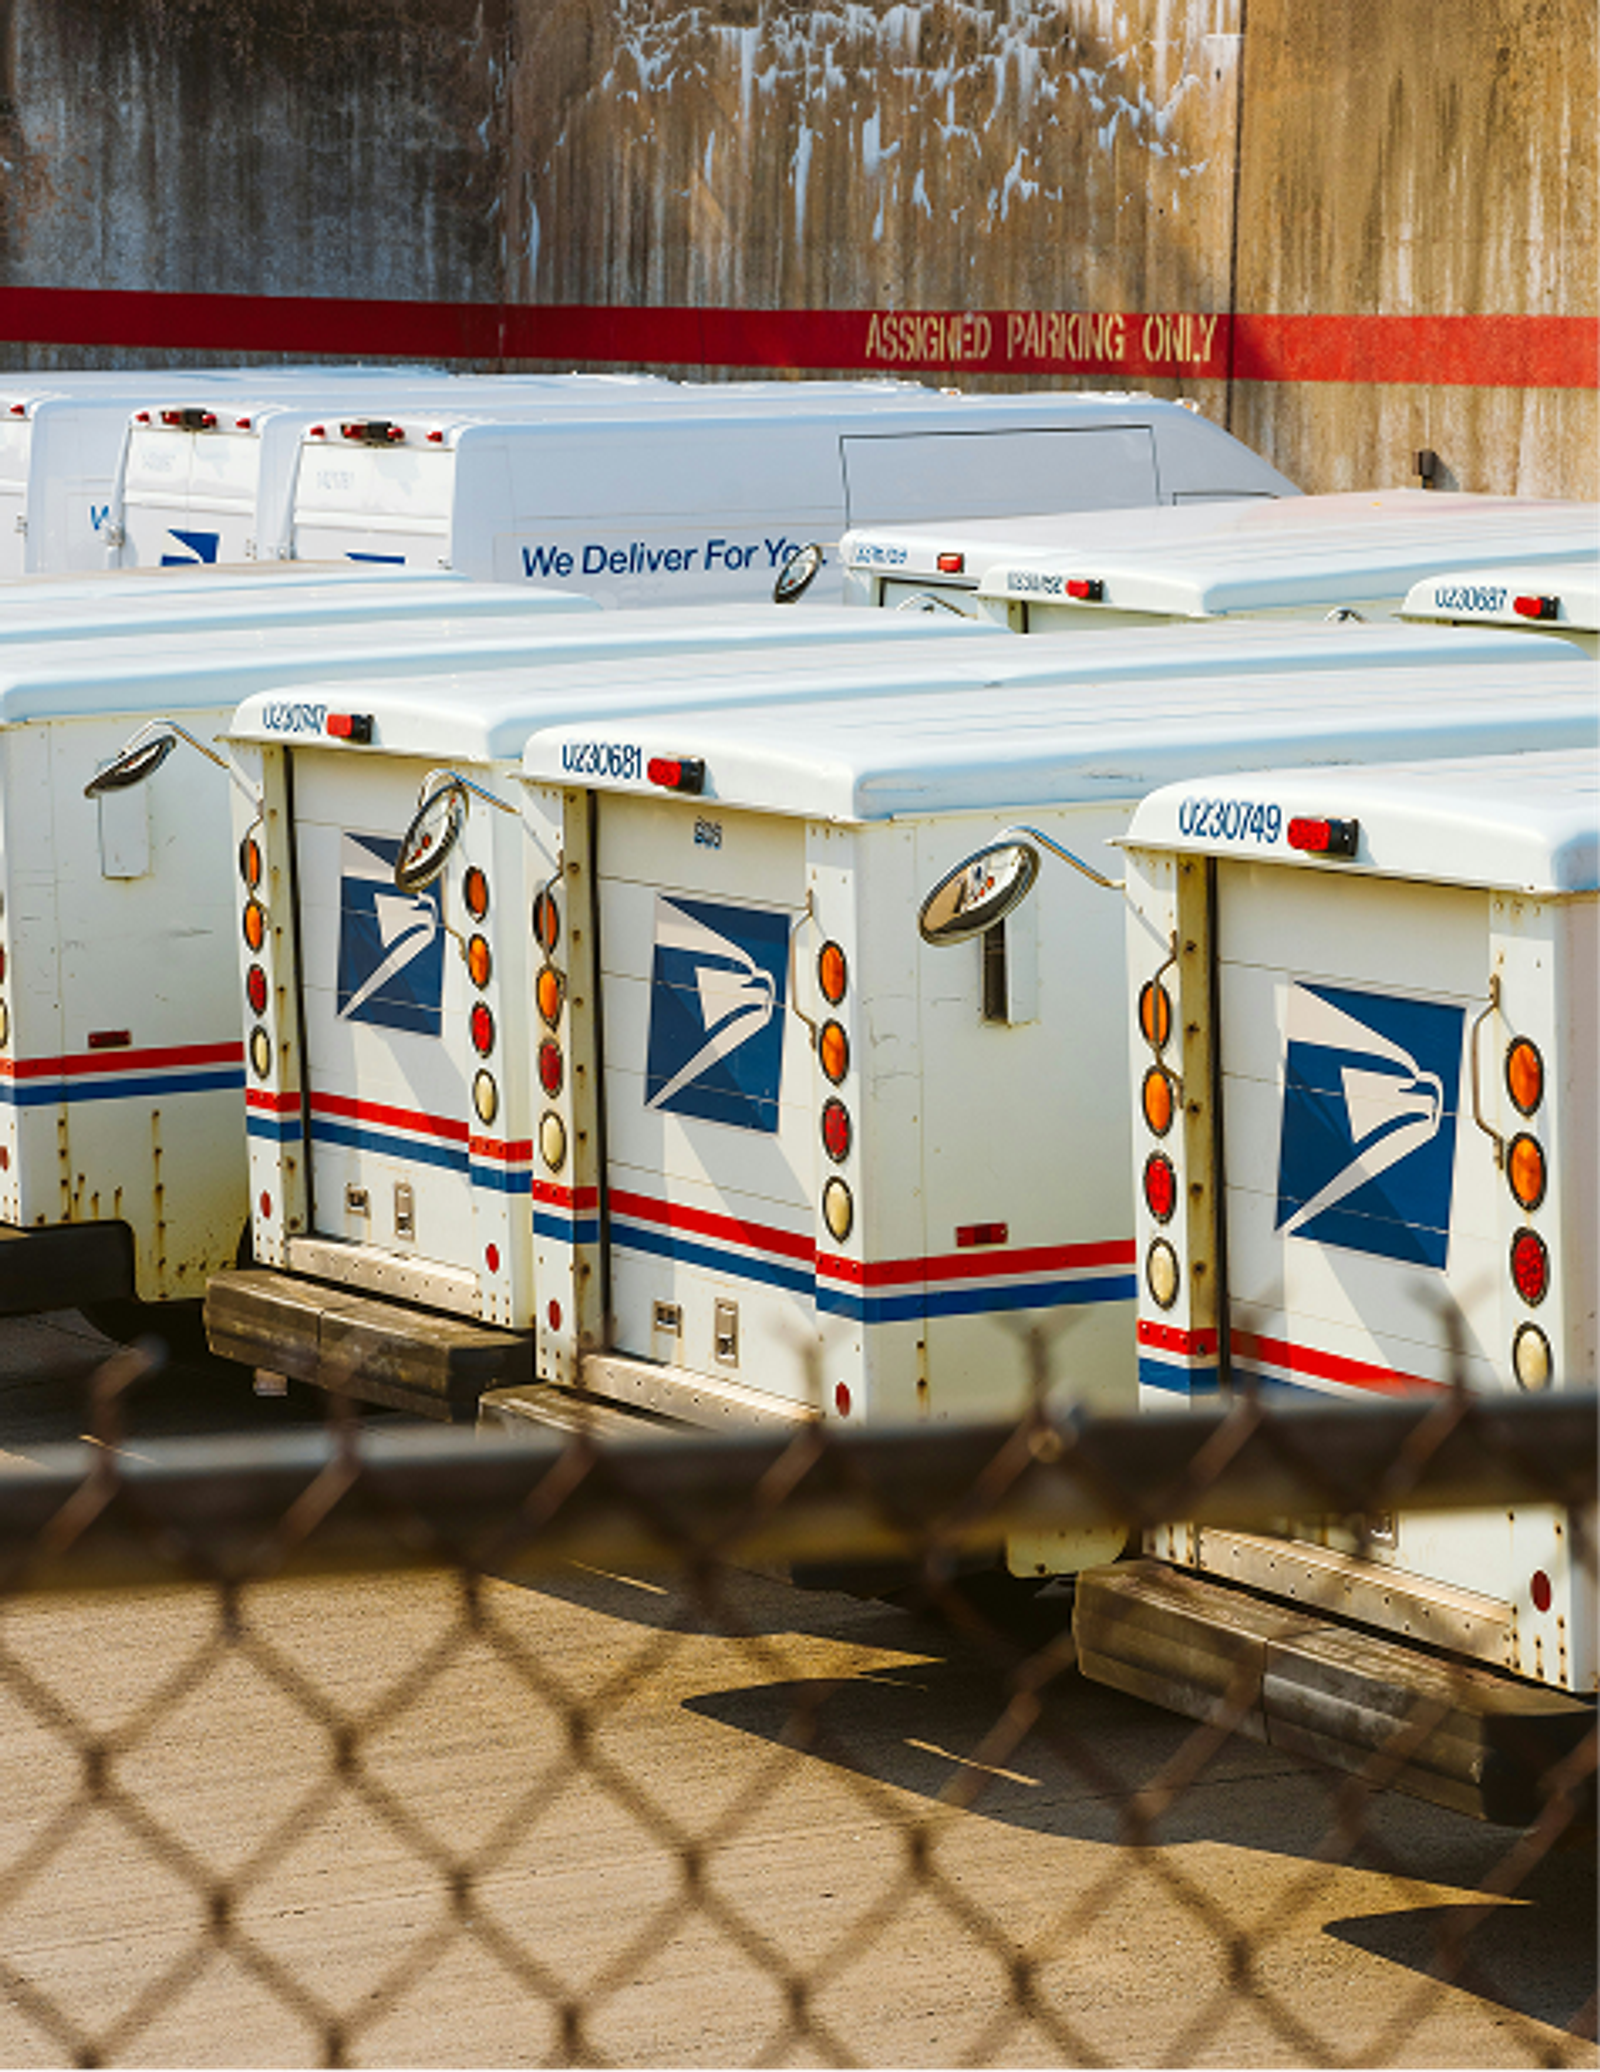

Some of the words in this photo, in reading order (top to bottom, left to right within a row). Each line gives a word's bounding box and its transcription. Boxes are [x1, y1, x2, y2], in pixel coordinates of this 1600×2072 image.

[865, 313, 992, 361] ASSIGNED
[1007, 313, 1124, 361] PARKING
[1143, 314, 1217, 362] ONLY
[522, 546, 574, 577] We
[582, 542, 698, 575] Deliver
[704, 539, 759, 571] For
[1179, 799, 1281, 843] 0230749
